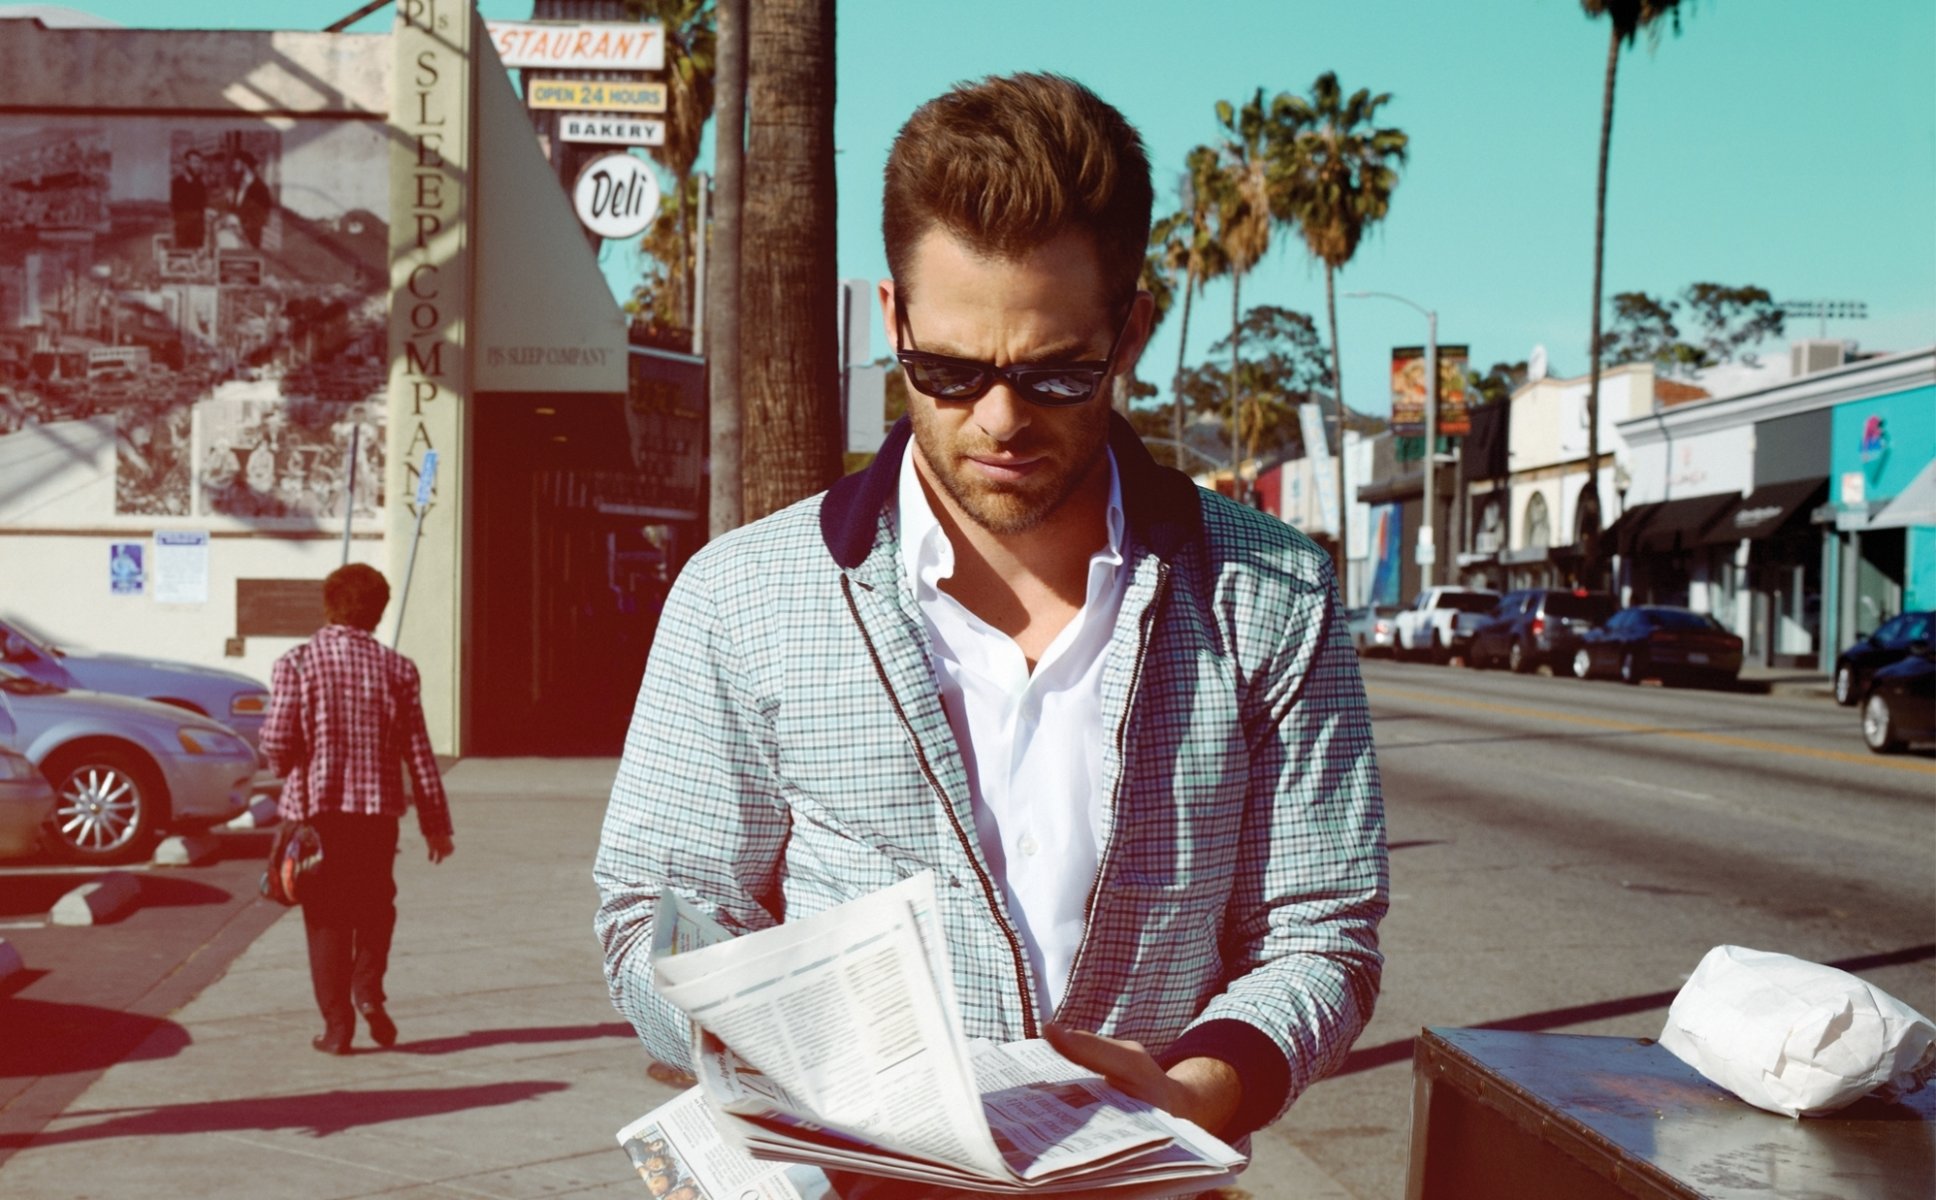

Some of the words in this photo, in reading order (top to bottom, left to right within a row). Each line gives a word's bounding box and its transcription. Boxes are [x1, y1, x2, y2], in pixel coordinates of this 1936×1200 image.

[489, 28, 656, 60] STAURANT
[534, 86, 575, 102] OPEN
[581, 85, 604, 104] 24
[609, 90, 660, 106] HOURS
[569, 122, 656, 138] BAKERY
[413, 51, 446, 249] SLEEP
[592, 168, 647, 218] Deli
